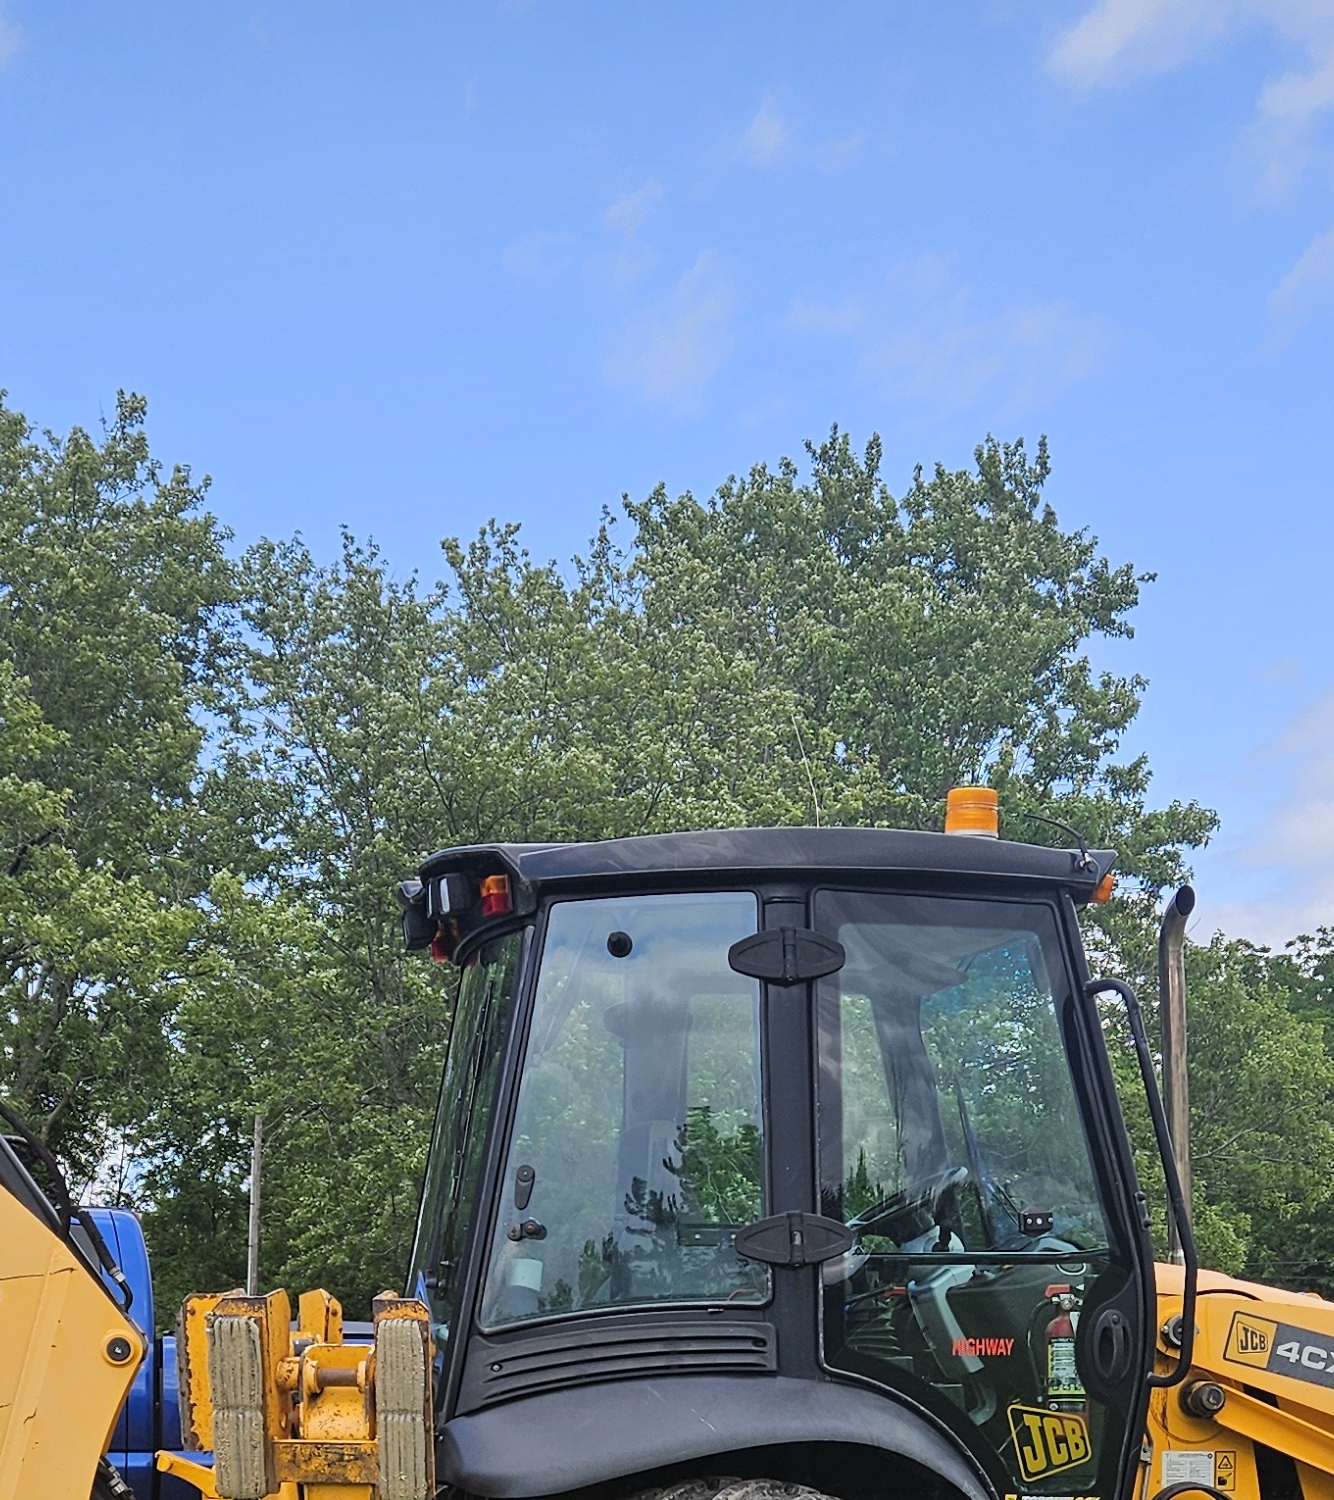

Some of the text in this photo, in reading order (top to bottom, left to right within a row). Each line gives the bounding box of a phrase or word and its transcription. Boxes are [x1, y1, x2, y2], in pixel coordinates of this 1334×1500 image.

[952, 1338, 1014, 1356] HIGHWAY
[1240, 1327, 1267, 1351] JCB
[1022, 1413, 1086, 1474] JCB
